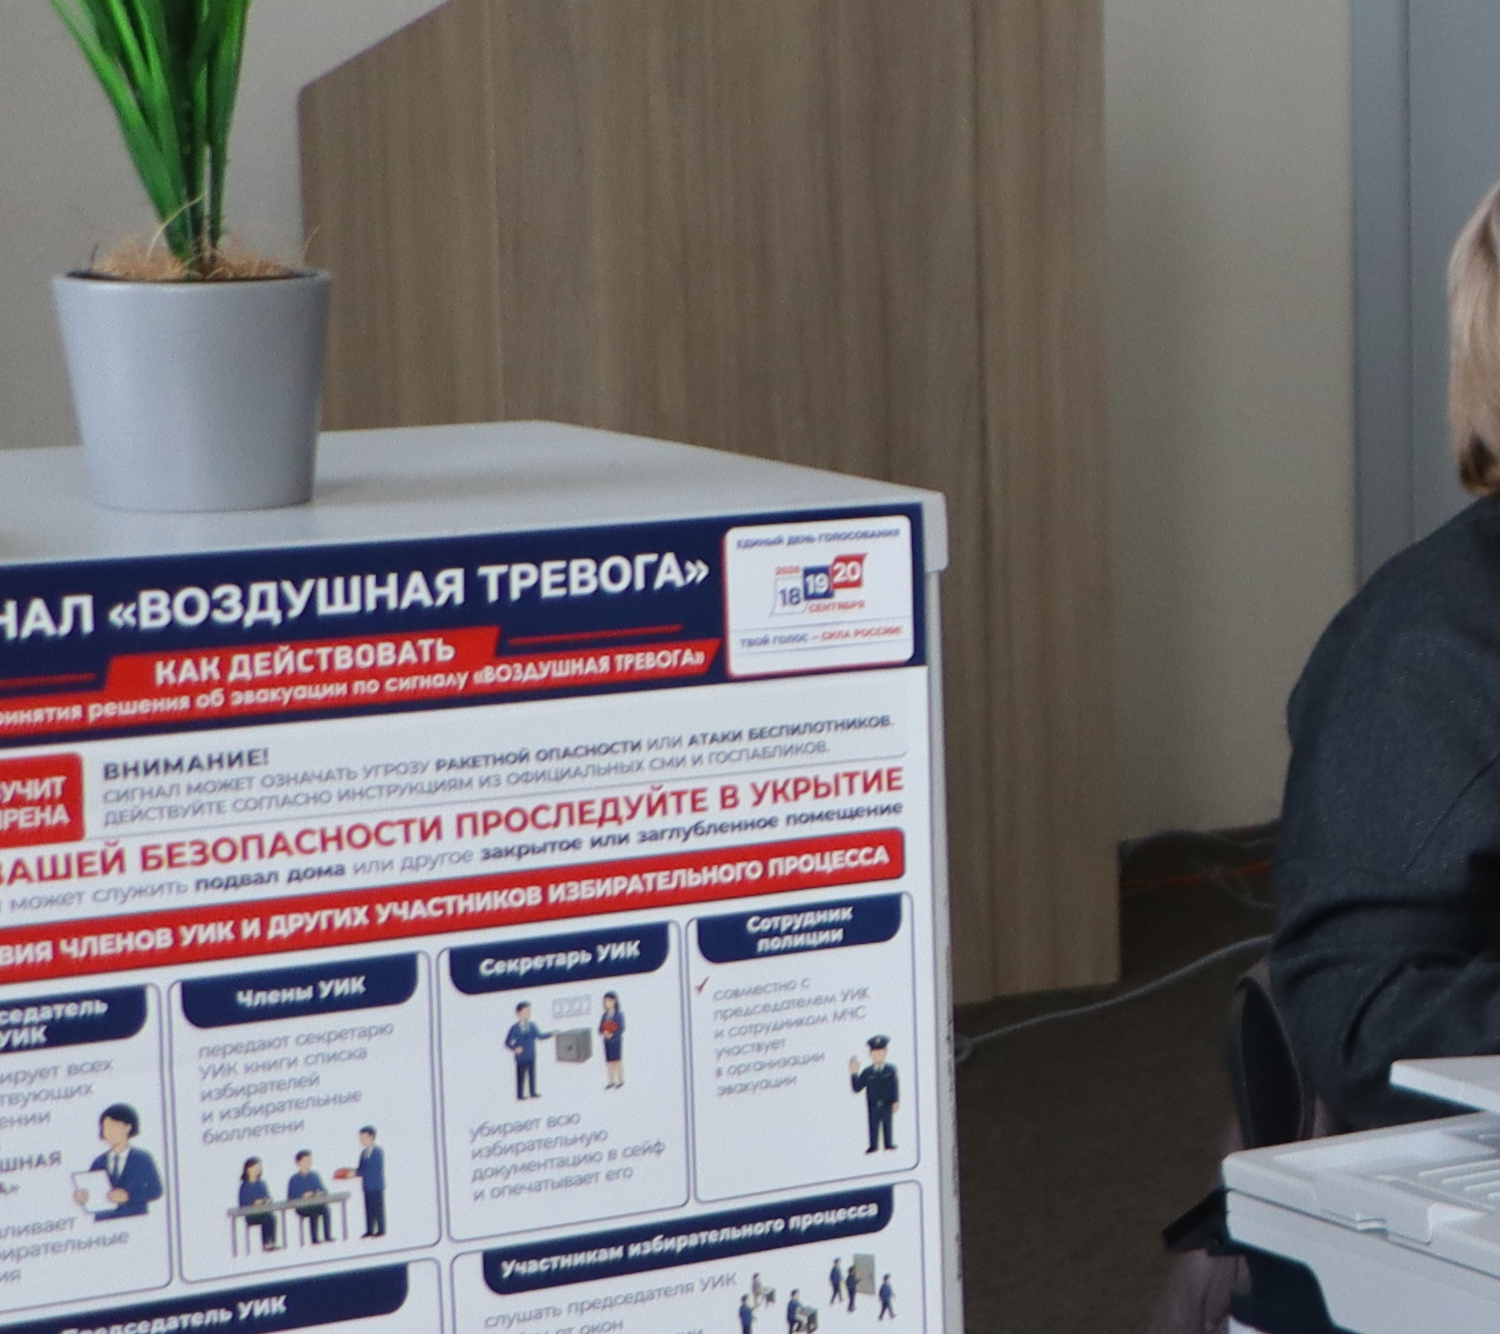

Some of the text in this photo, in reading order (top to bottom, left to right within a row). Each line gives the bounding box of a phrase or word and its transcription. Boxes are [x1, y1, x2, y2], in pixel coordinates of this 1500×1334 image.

[108, 567, 464, 629] «ВОЗДУШНАЯ
[476, 551, 709, 602] ТРЕВОГА»
[804, 572, 829, 594] 19
[832, 560, 862, 582] 20
[778, 586, 802, 606] 18
[154, 637, 455, 685] КАК ДЕЙСТВОВАТЬ
[86, 694, 190, 723] решения
[194, 687, 225, 709] об
[230, 681, 347, 706] эвакуации
[351, 678, 380, 695] по
[383, 670, 469, 692] сигналу
[472, 654, 610, 684] «ВОЗДУШНАЯ
[613, 647, 705, 672] ТРЕВОГА»
[102, 714, 895, 802] СИГНАЛ МОЖЕТ ОЗНАЧАТЬ УГРОЗУ РАКЕТНОЙ ОПАСНОСТИ ИЛИ АТАКИ БЕСПИЛОТНИКОВ.
[103, 748, 268, 780] ВНИМАНИЕ!
[103, 739, 832, 828] ДЕЙСТВУЙТЕ СОГЛАСНО ИНСТРУКЦИЯМ ИЗ ОФИЦИАЛЬНЫХ СМИ И ГОСПАБЛИКОВ.
[0, 766, 903, 886] АШЕЙ БЕЗОПАСНОСТИ ПРОСЛЕДУЙТЕ В УКРЫТИЕ
[9, 802, 903, 911] может служить подвал дома или другое закрытое или заглубленное помещение
[58, 926, 174, 959] ЧЛЕНОВ
[178, 919, 235, 947] УИК
[240, 916, 261, 940] И
[266, 904, 370, 940] ДРУГИХ
[374, 884, 542, 925] УЧАСТНИКОВ
[547, 859, 763, 904] ИЗБИРАТЕЛЬНОГО
[767, 844, 890, 878] ПРОЦЕССА
[745, 906, 853, 933] Сотрудник
[478, 939, 640, 976] Секретарь УИК
[756, 927, 843, 952] полиции
[236, 975, 366, 1007] Члены УИК
[500, 1202, 878, 1278] Участникам избирательного процесса
[236, 1294, 286, 1320] УИК
